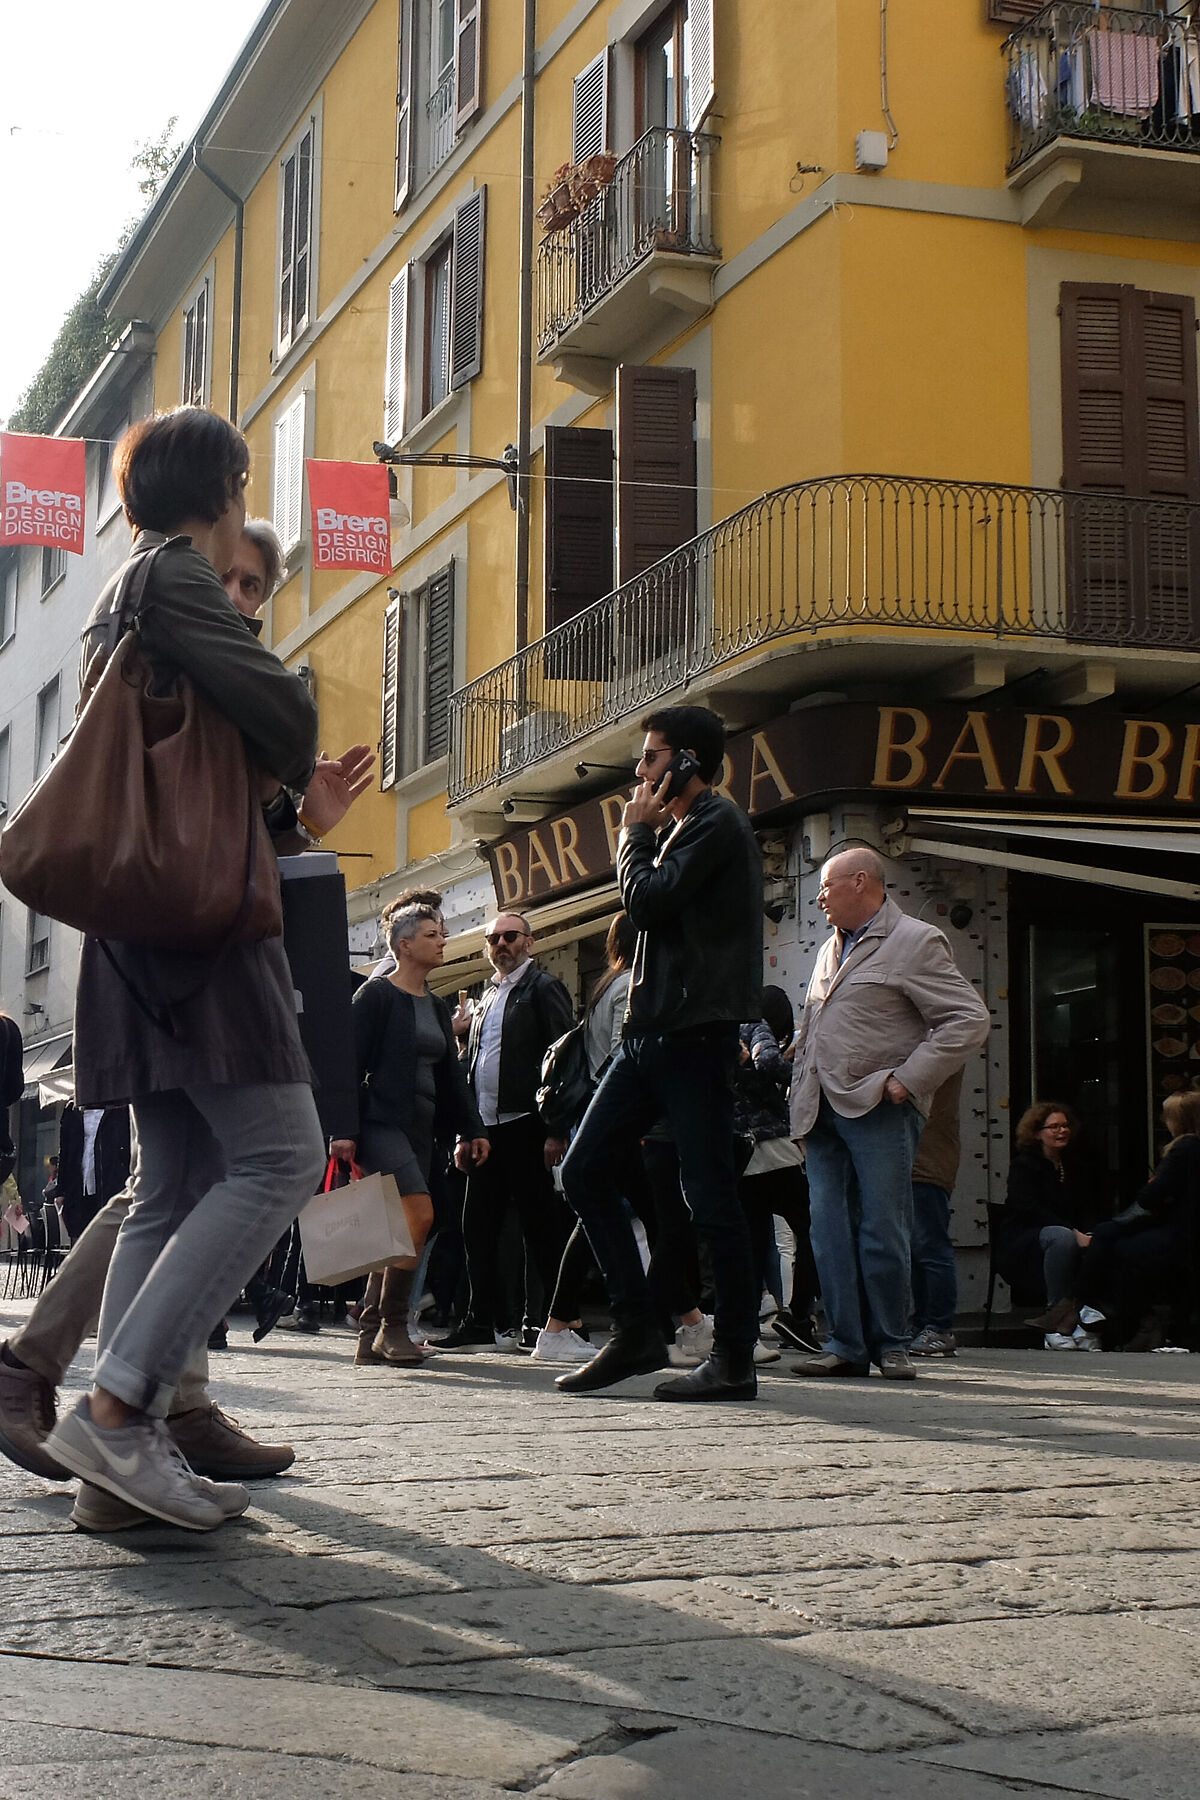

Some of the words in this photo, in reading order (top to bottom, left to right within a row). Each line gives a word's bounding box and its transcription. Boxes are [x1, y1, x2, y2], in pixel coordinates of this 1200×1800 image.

[6, 481, 81, 511] Brera
[5, 506, 81, 528] DESIGN
[317, 508, 388, 536] Brera
[5, 521, 80, 542] DISTRICT
[318, 532, 388, 552] DESIGN
[319, 547, 387, 567] DISTRICT
[871, 706, 1075, 796] BAR
[493, 816, 589, 905] BAR
